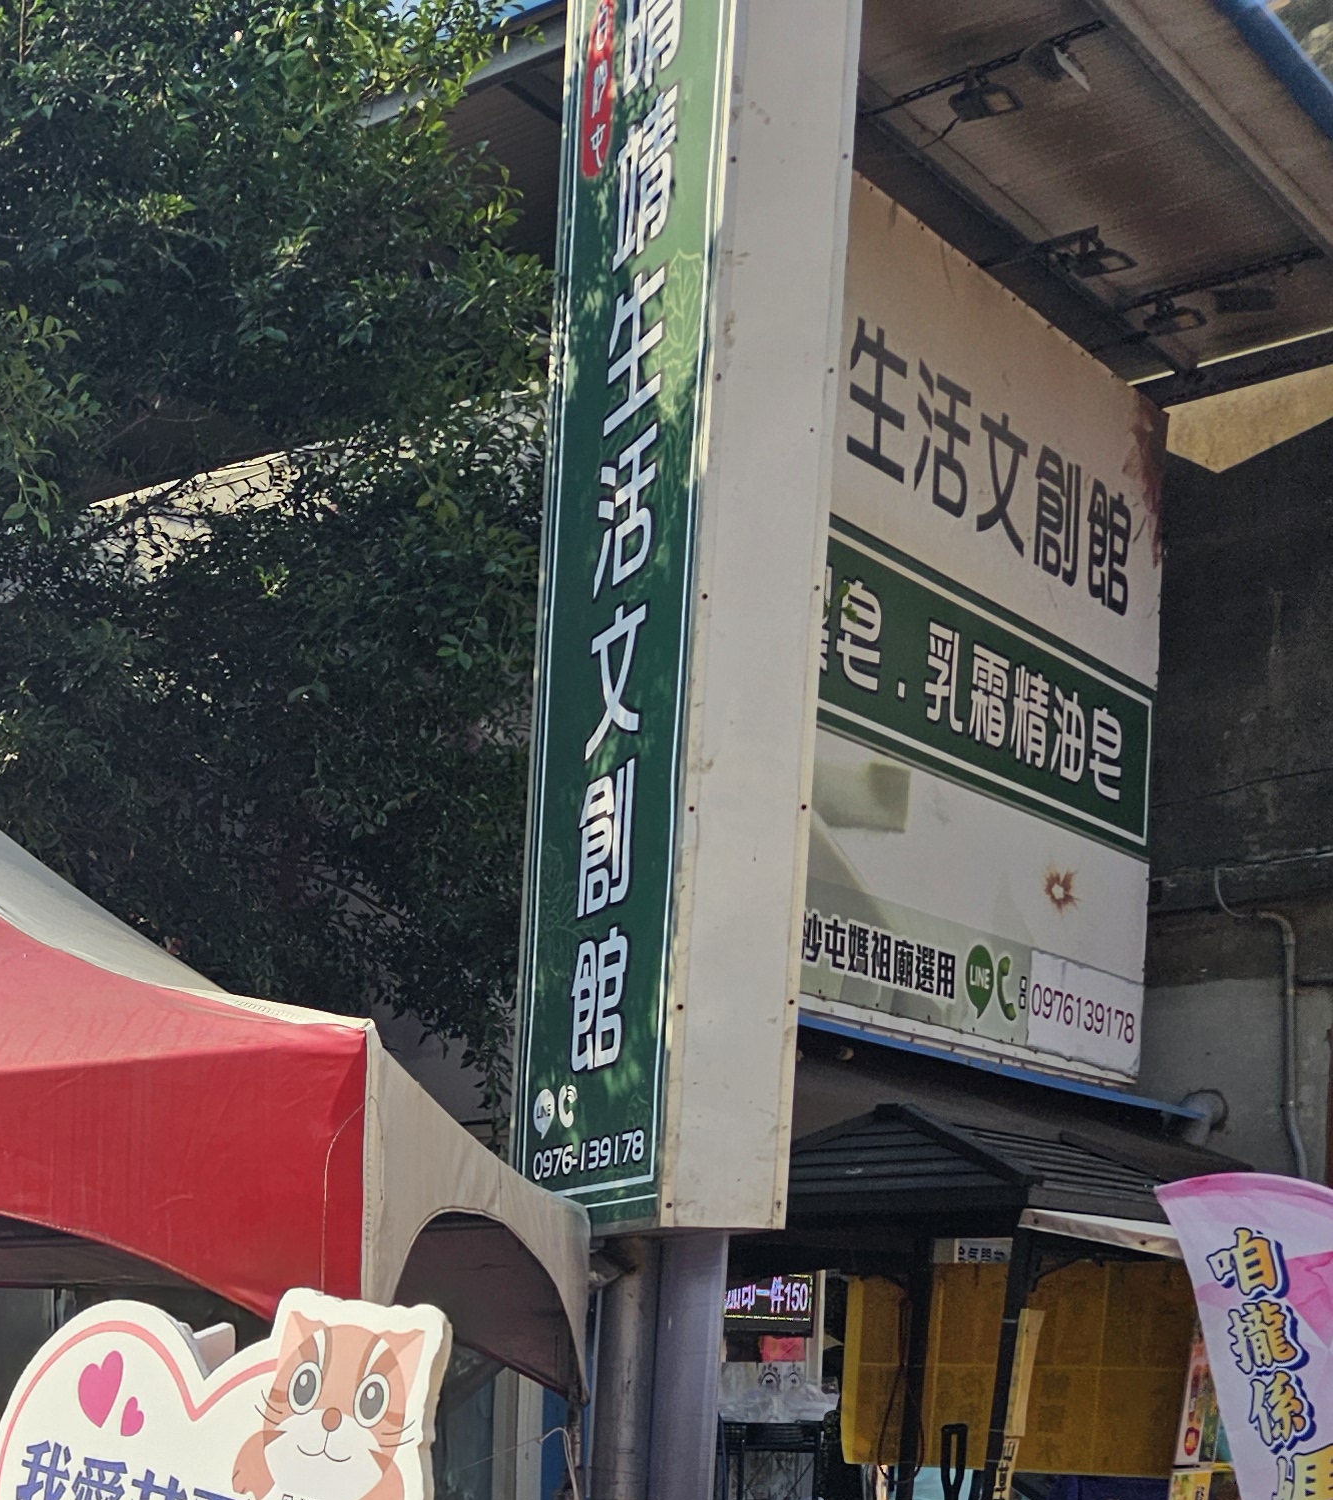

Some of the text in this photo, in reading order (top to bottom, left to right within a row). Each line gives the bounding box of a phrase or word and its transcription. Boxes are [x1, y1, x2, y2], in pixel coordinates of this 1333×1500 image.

[846, 316, 1133, 617] 生活文創館
[969, 963, 991, 991] LINE
[1032, 983, 1136, 1045] 0976139178
[536, 1103, 552, 1119] LINE
[533, 1129, 645, 1181] 0976-139178
[1206, 1227, 1313, 1452] 咱攏係
